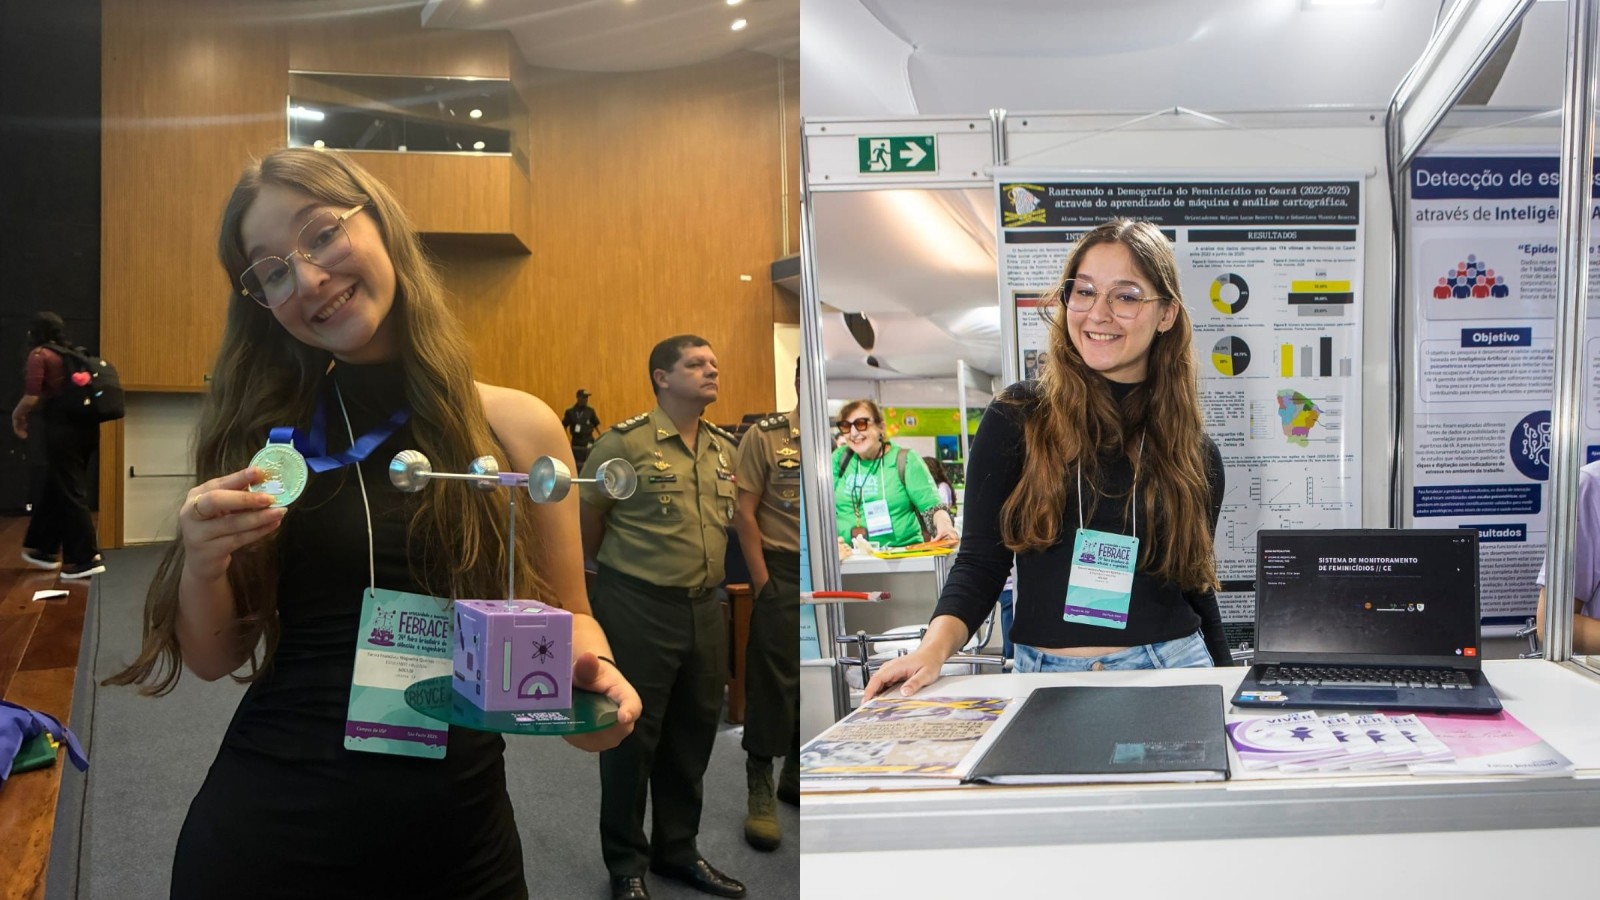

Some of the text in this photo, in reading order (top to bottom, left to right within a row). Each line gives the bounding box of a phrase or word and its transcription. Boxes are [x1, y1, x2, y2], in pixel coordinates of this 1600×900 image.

[1416, 169, 1503, 190] Detecção
[1510, 169, 1532, 186] de
[1049, 187, 1104, 196] Rastreando
[1118, 187, 1173, 197] Demografia
[1176, 187, 1188, 196] do
[1192, 186, 1251, 196] Feminicídio
[1269, 186, 1296, 195] Ceará
[1300, 186, 1350, 196] (2022-2025)
[1055, 198, 1092, 208] através
[1095, 198, 1107, 207] do
[1111, 198, 1170, 209] aprendizado
[1174, 198, 1185, 207] de
[1189, 198, 1229, 208] máquina
[1242, 198, 1279, 206] análise
[1416, 206, 1469, 221] através
[1473, 206, 1491, 220] de
[1248, 231, 1297, 239] RESULTADOS
[1472, 333, 1520, 345] Objetivo
[1098, 543, 1131, 560] FEBRACE
[1329, 564, 1374, 572] FEMINICÍDIOS
[399, 611, 448, 638] FEBRACE
[1266, 714, 1311, 724] VIVER
